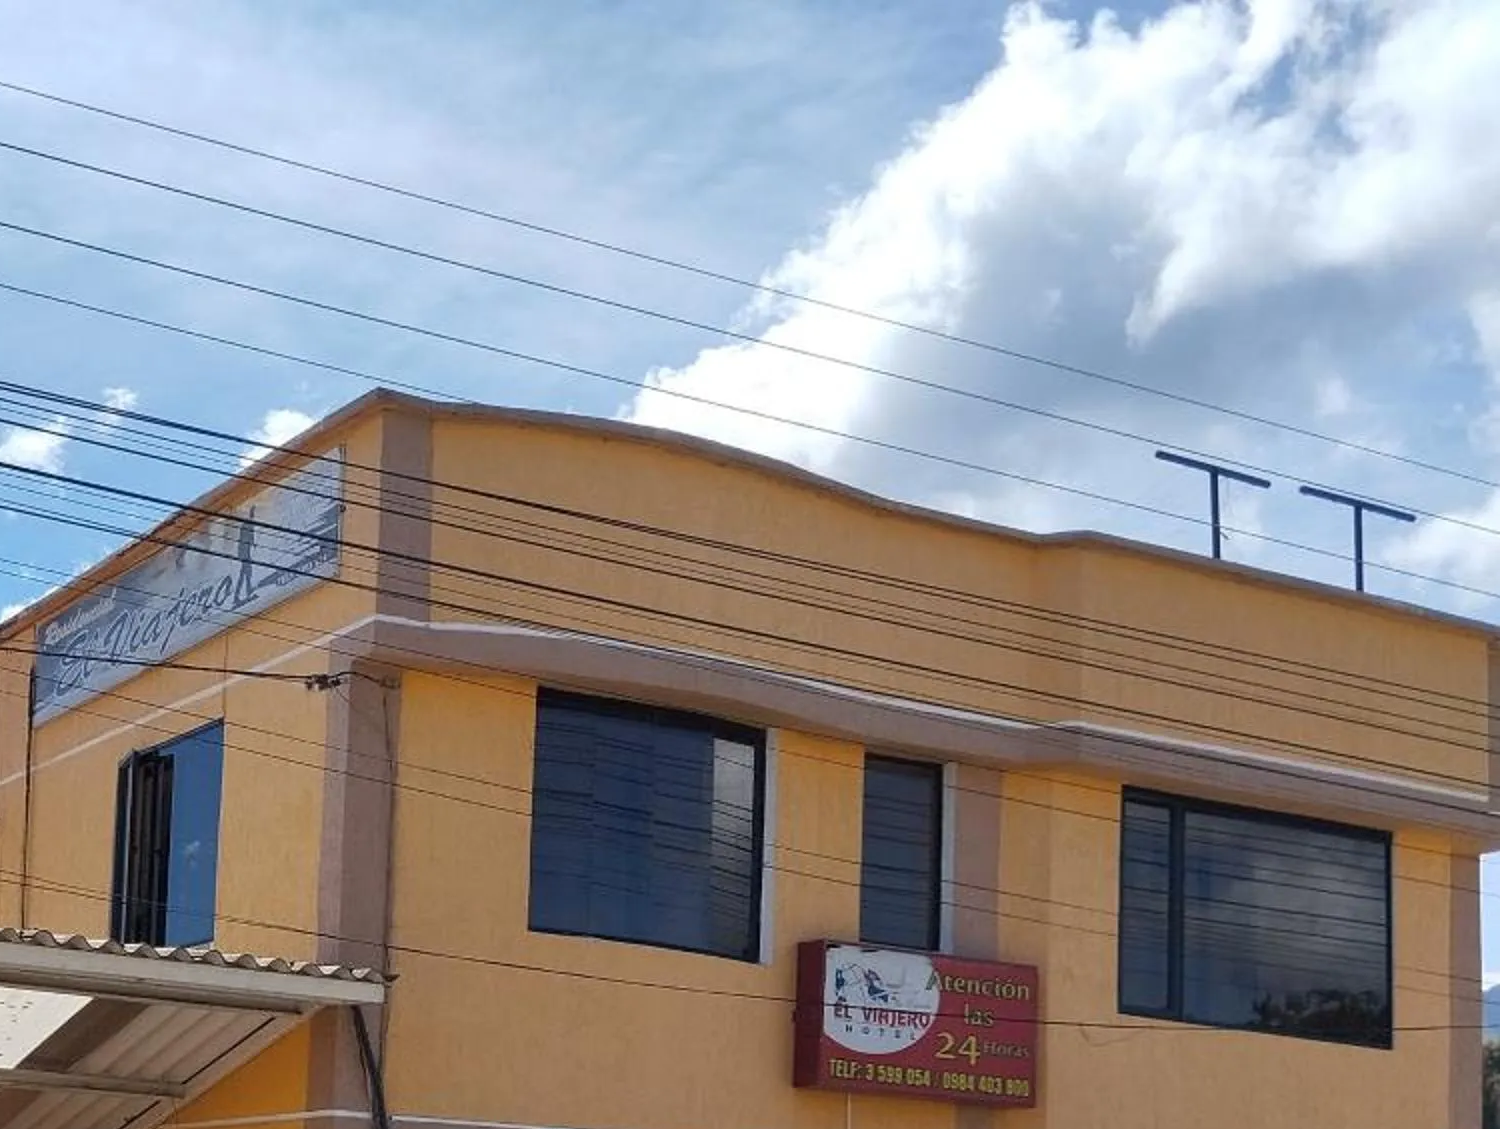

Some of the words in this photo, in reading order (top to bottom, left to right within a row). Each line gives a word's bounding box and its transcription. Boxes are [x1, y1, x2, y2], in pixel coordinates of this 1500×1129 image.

[925, 970, 1030, 1000] Atención
[834, 1003, 853, 1019] EL
[862, 1007, 932, 1029] VIAJERO
[964, 1003, 995, 1027] las
[845, 1024, 917, 1041] HOTEL
[933, 1031, 981, 1066] 24
[983, 1041, 1030, 1058] Horas
[866, 1063, 875, 1081] 3
